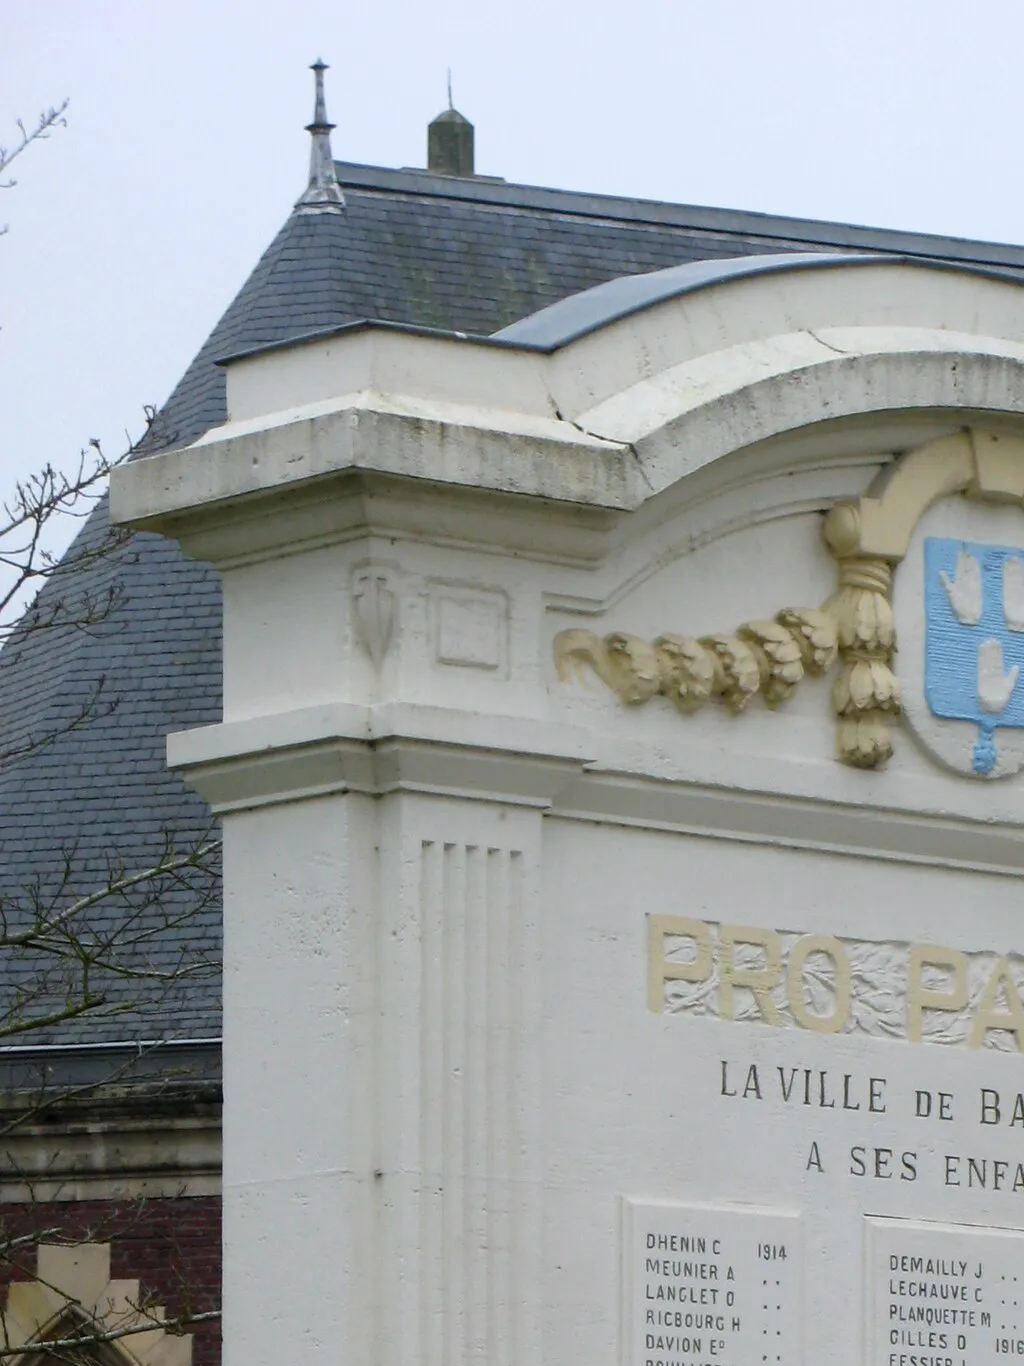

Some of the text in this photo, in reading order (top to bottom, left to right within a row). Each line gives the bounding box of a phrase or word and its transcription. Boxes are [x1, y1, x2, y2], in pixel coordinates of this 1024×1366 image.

[647, 914, 849, 1035] PRO
[720, 1060, 763, 1100] LA
[777, 1067, 887, 1113] VILLE
[915, 1090, 954, 1121] DE
[806, 1141, 825, 1173] A
[849, 1147, 918, 1182] SES
[645, 1232, 787, 1260] DHENIN C 1914
[645, 1257, 735, 1282] MEUNIER A
[889, 1254, 983, 1280] DEMAILLY J
[645, 1308, 741, 1332] RICBOURG H
[888, 1303, 992, 1328] PLANQUETTE M
[889, 1328, 1024, 1355] GILLES O 1916
